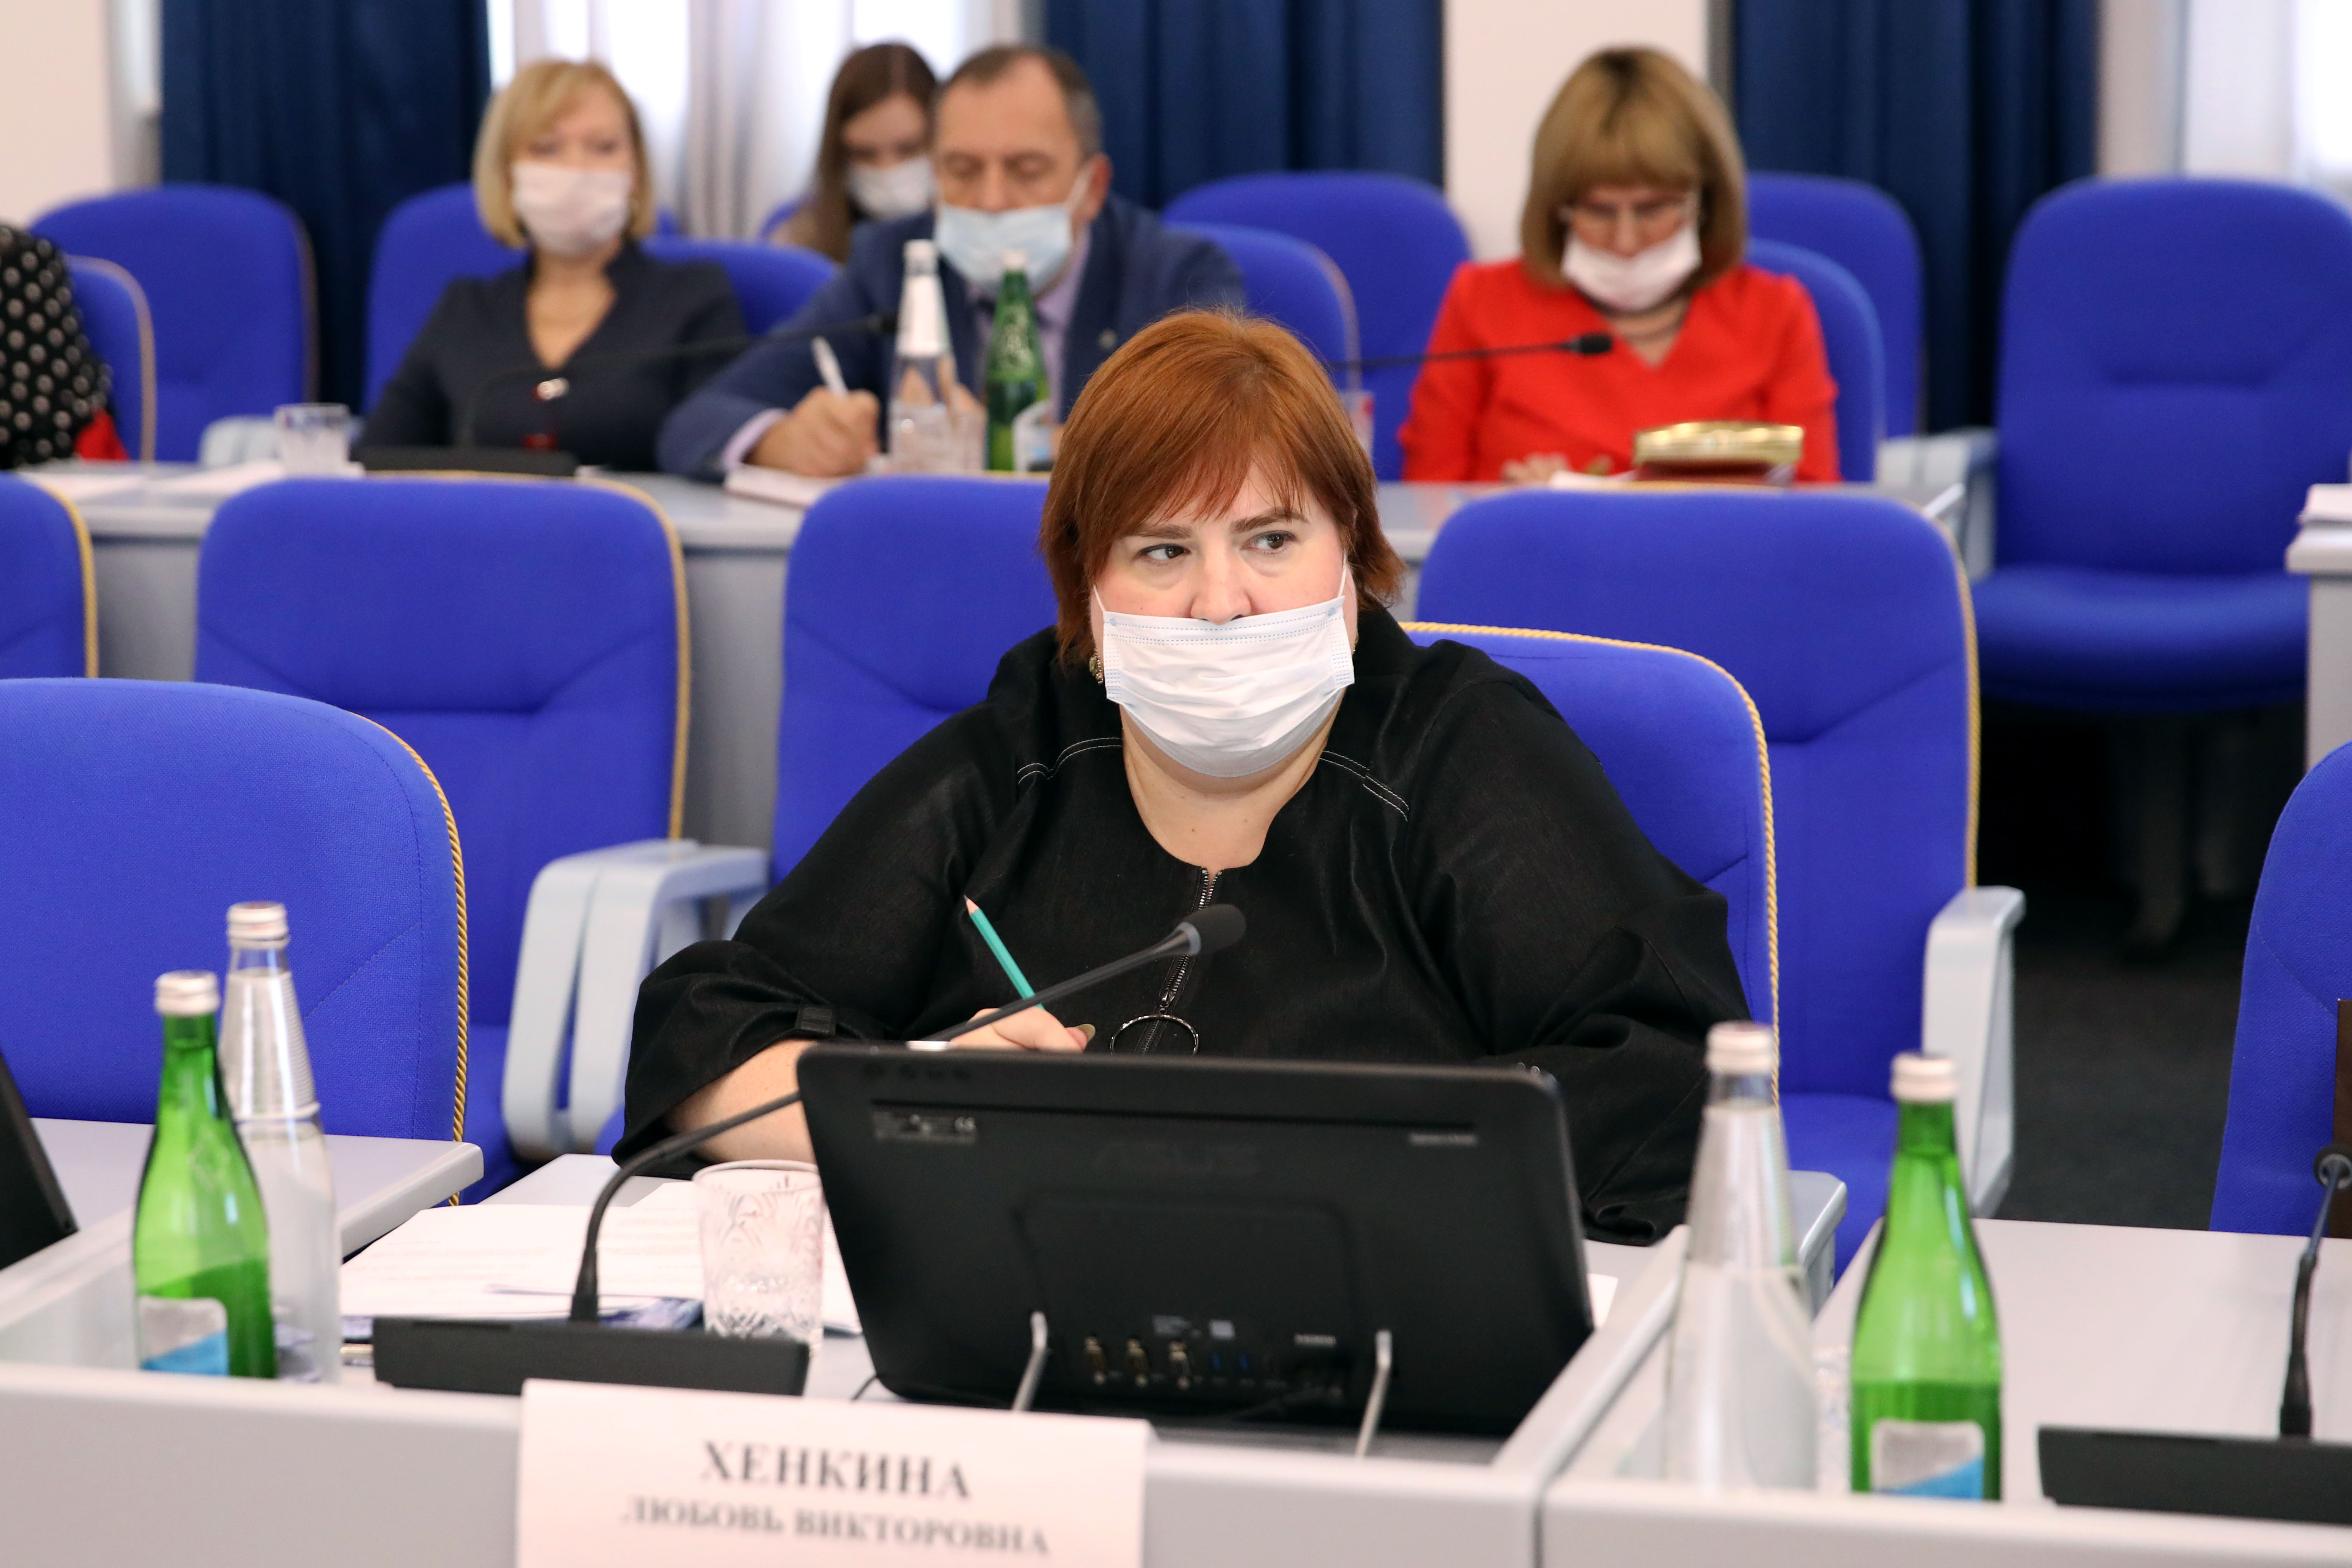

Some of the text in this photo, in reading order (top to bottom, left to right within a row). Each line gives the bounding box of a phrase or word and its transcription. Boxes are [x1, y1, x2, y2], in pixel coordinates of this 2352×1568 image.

[700, 1439, 972, 1500] ХЕНКИНА
[622, 1497, 1050, 1555] ЛЮБОВЬ ВИКТОРОВНА
